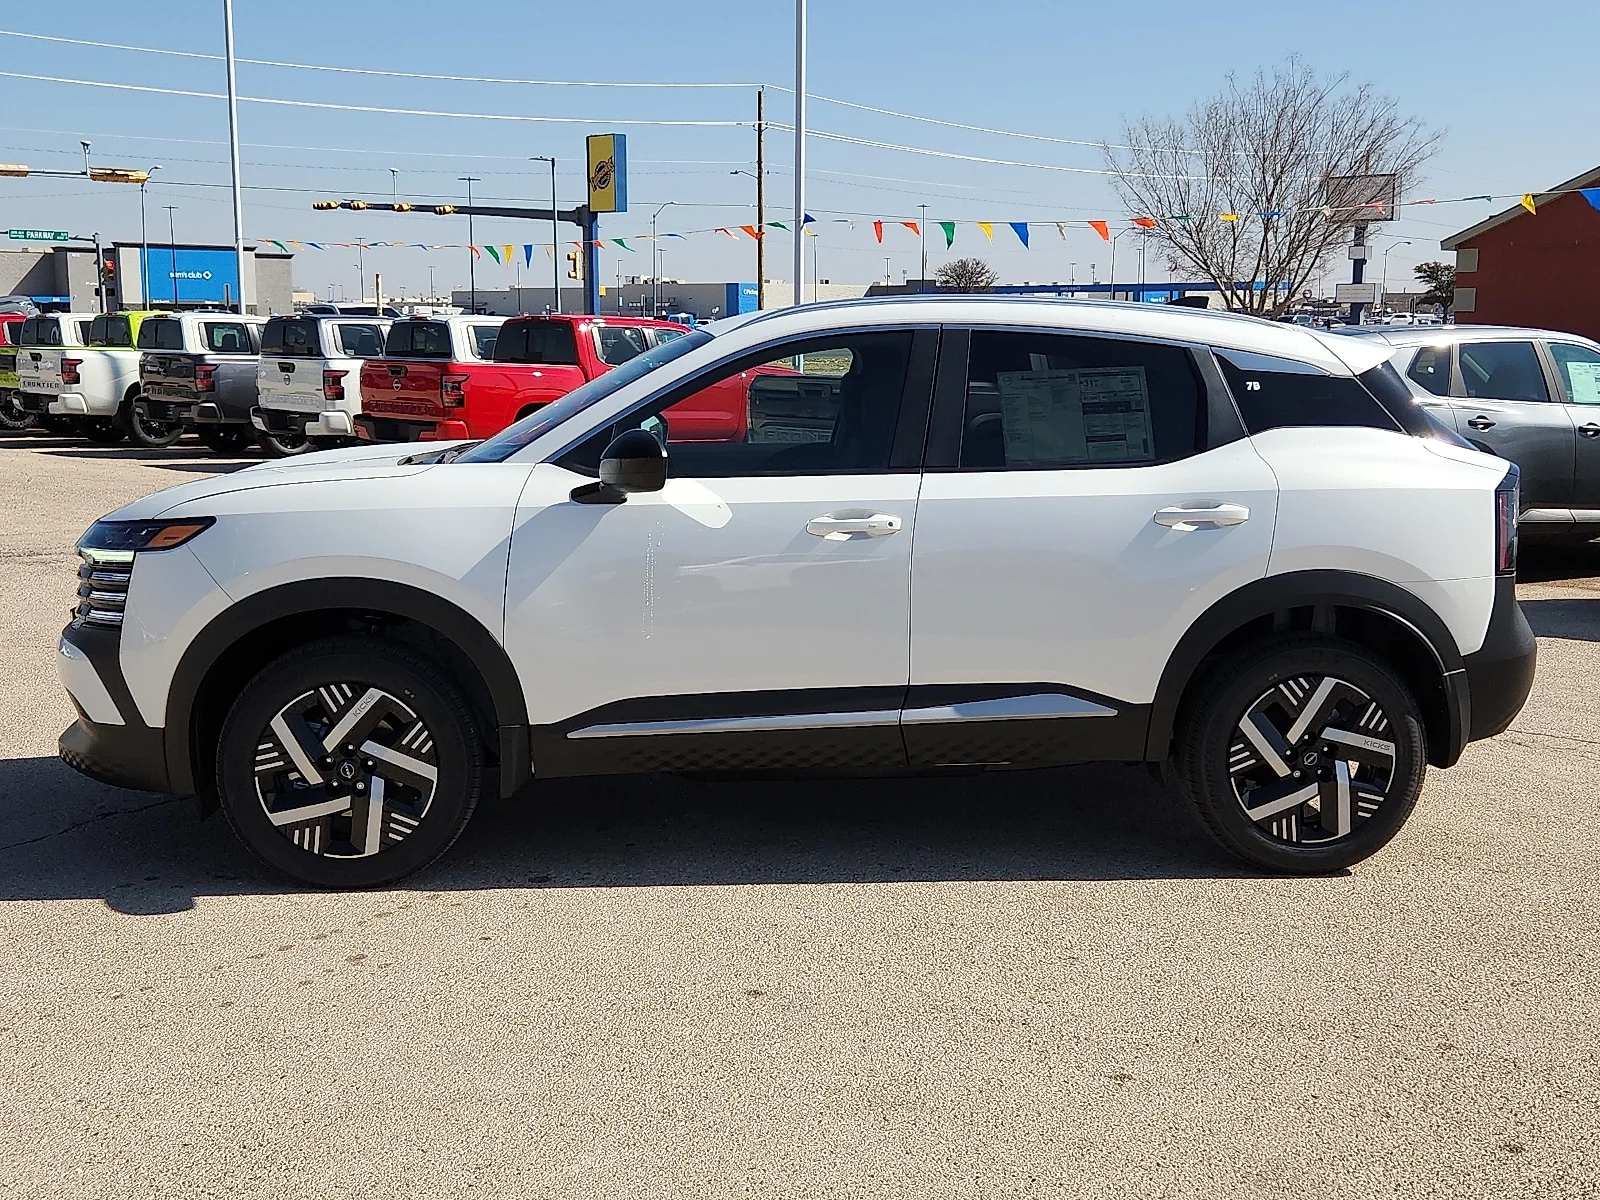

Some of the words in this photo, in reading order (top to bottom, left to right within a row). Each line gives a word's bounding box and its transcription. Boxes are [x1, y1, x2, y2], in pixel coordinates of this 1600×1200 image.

[26, 231, 55, 239] PARKWAY
[188, 271, 202, 279] club
[352, 692, 376, 718] KICKS
[1363, 739, 1391, 751] KICKS
